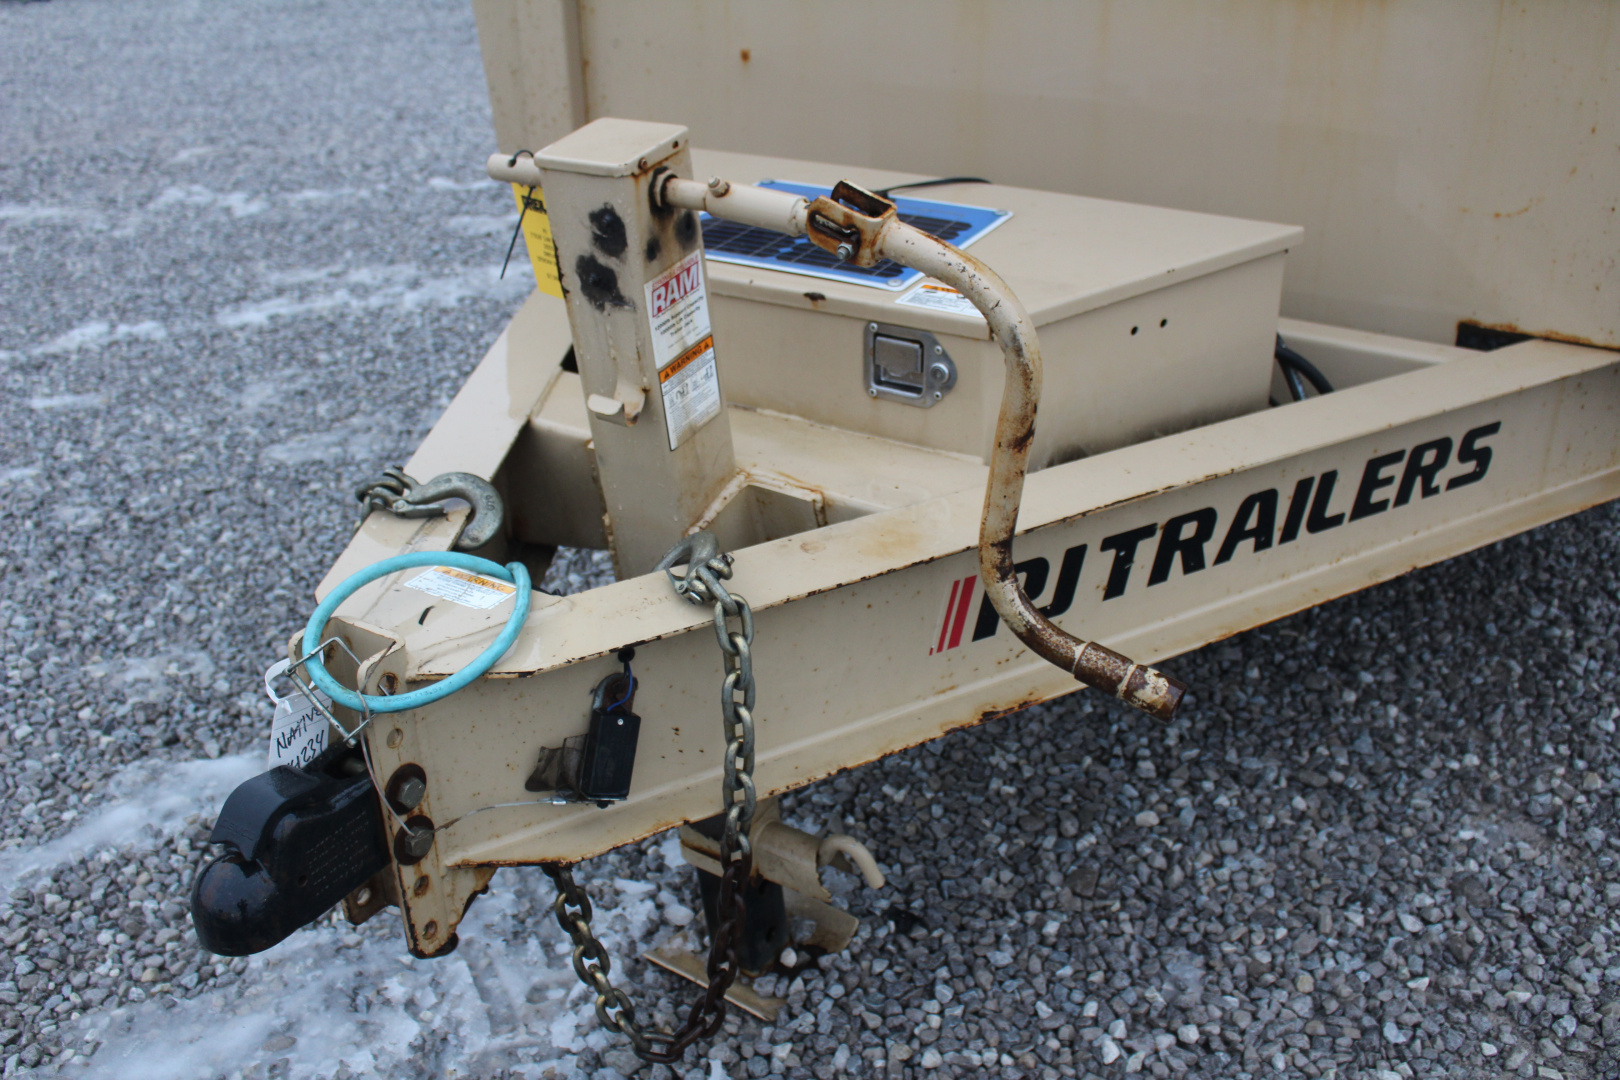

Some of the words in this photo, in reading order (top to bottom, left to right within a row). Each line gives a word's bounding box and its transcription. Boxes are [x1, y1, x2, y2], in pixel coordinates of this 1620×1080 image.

[653, 264, 698, 315] RAM
[670, 345, 703, 374] WARNING
[1100, 420, 1502, 602] TRAILERS
